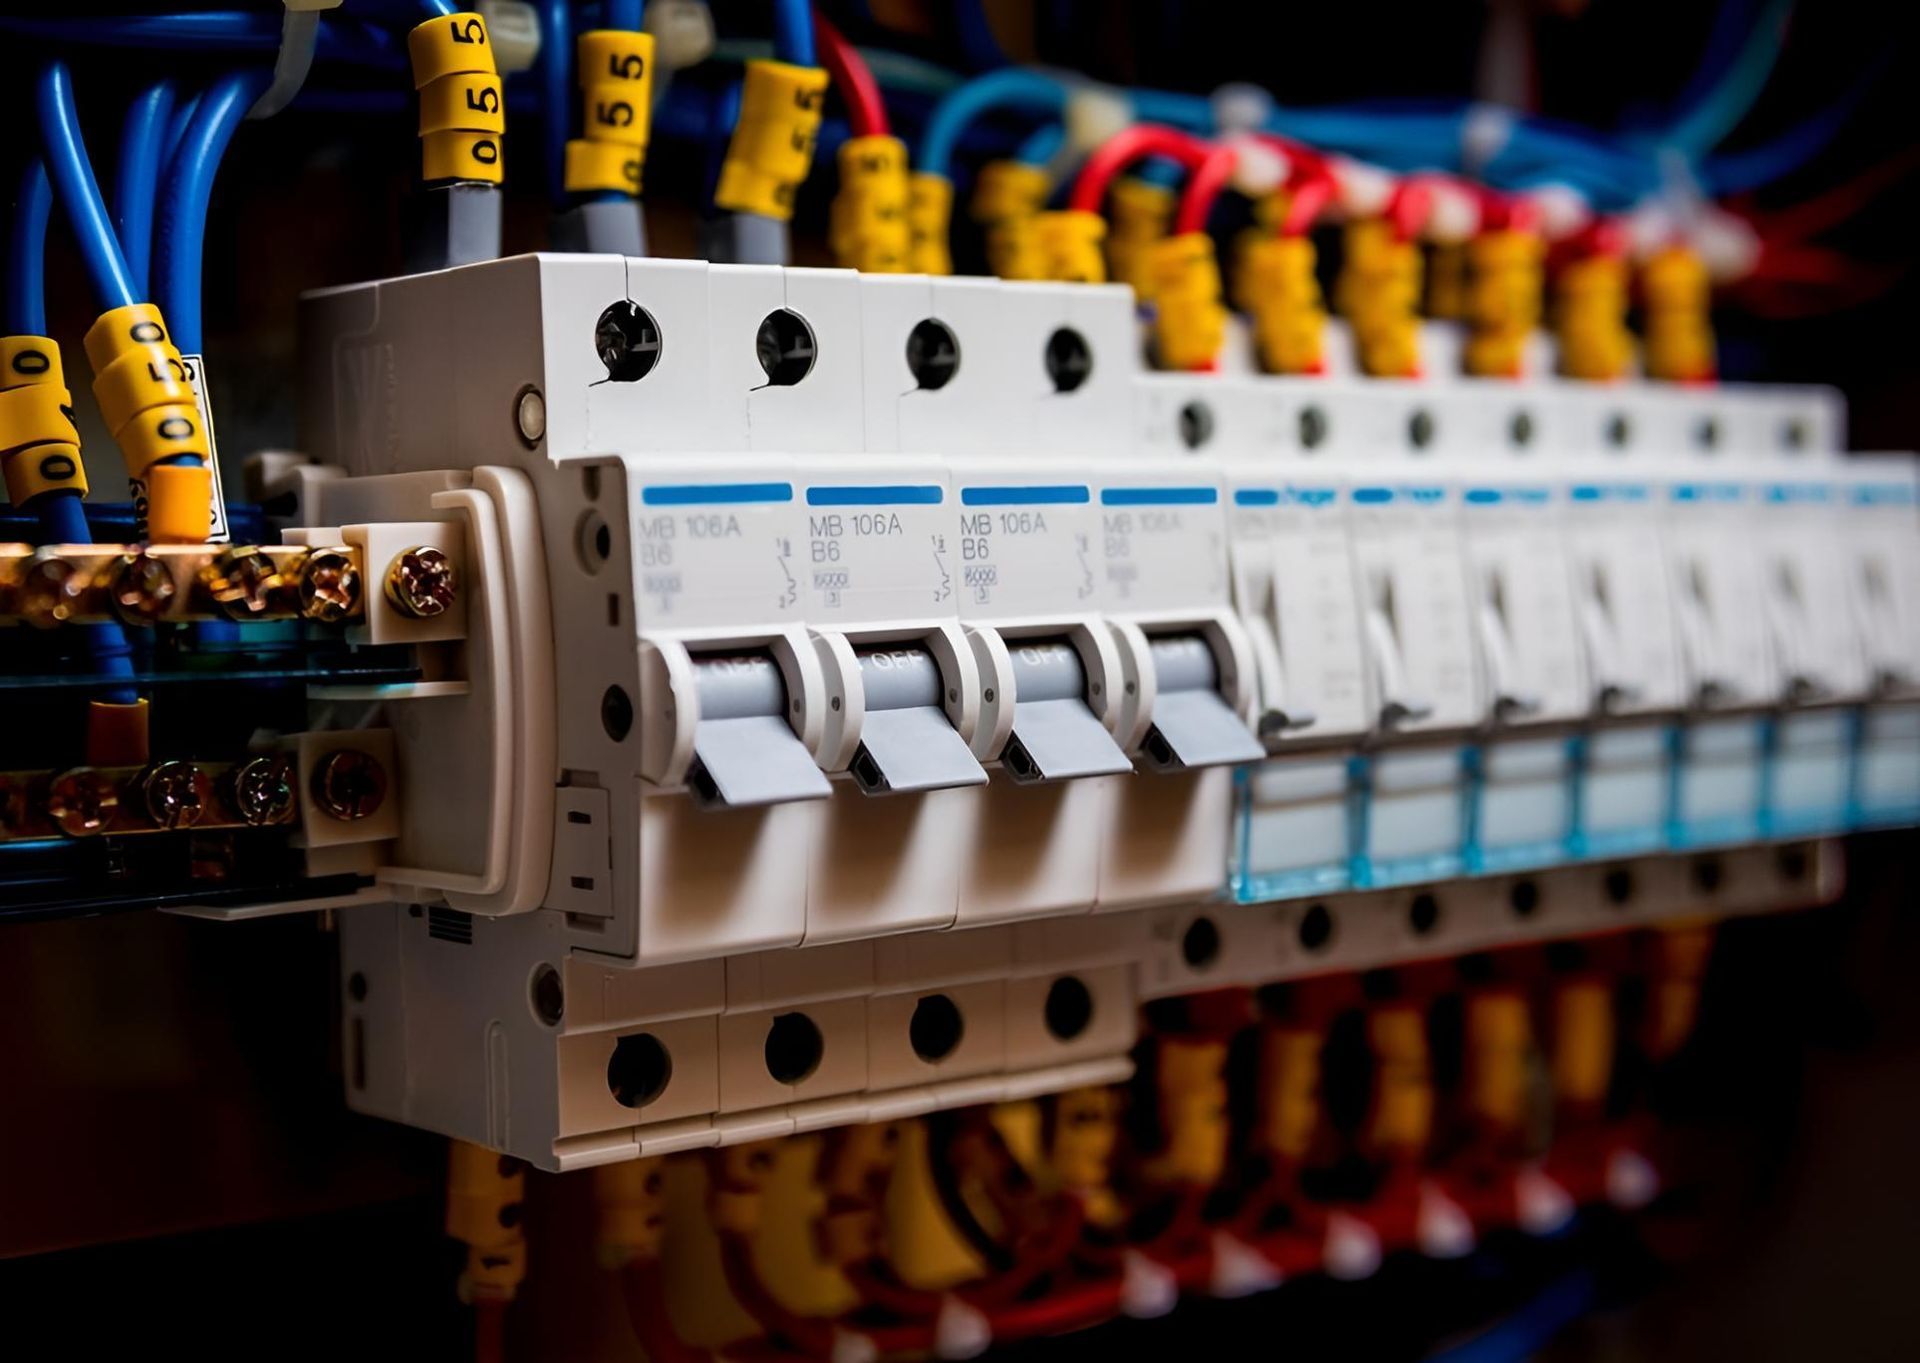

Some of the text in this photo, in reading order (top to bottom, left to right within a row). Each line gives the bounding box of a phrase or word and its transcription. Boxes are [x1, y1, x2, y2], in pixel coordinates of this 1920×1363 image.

[639, 515, 675, 540] MB
[809, 512, 903, 538] MB 106A
[961, 511, 1048, 536] MB 106A
[811, 540, 841, 563] B6
[962, 538, 990, 561] B6
[870, 650, 925, 670] OFF
